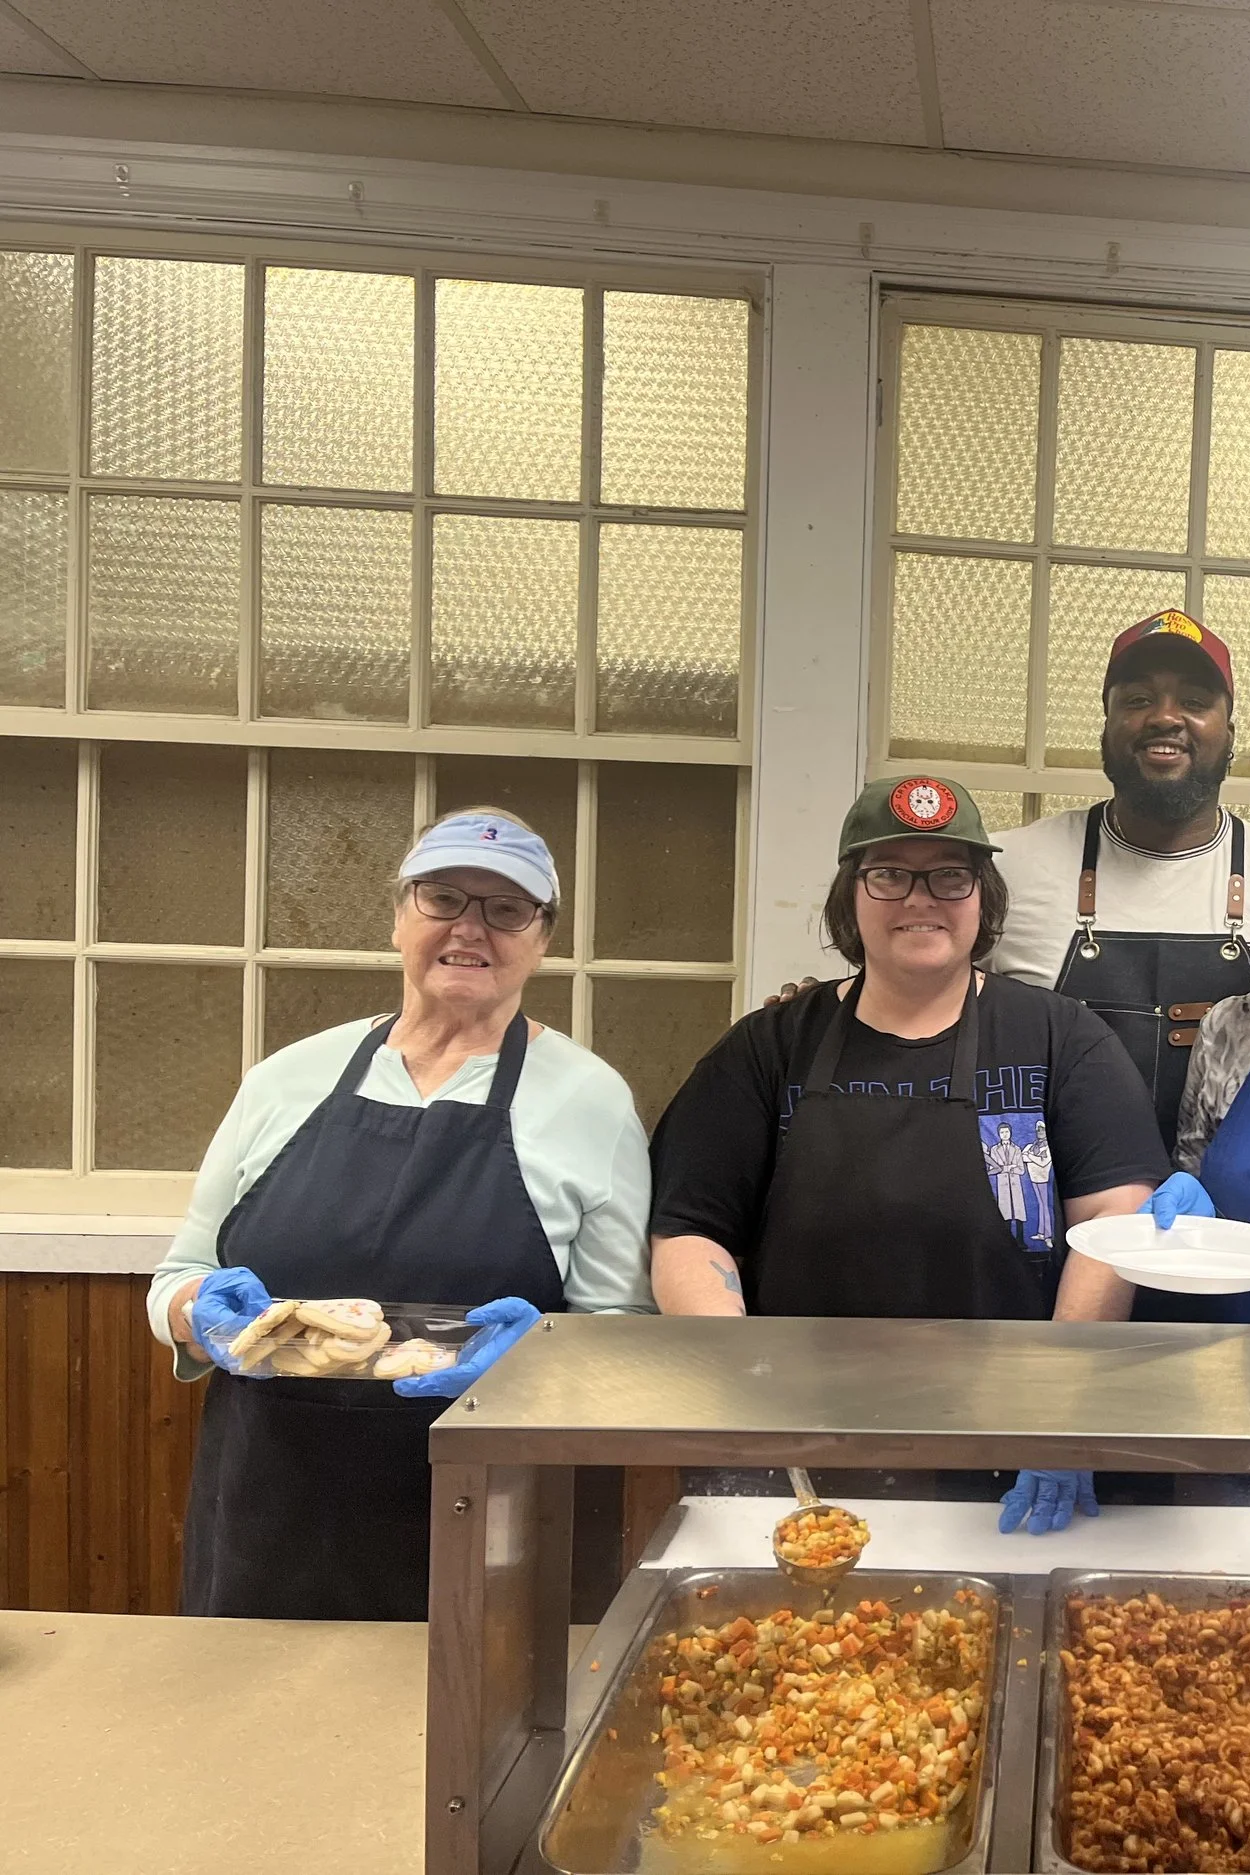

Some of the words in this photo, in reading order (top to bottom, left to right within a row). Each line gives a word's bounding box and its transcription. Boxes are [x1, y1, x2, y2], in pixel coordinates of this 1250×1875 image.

[895, 780, 930, 799] CRYSTAL
[936, 784, 954, 802] LAKE
[920, 818, 940, 826] TOUR
